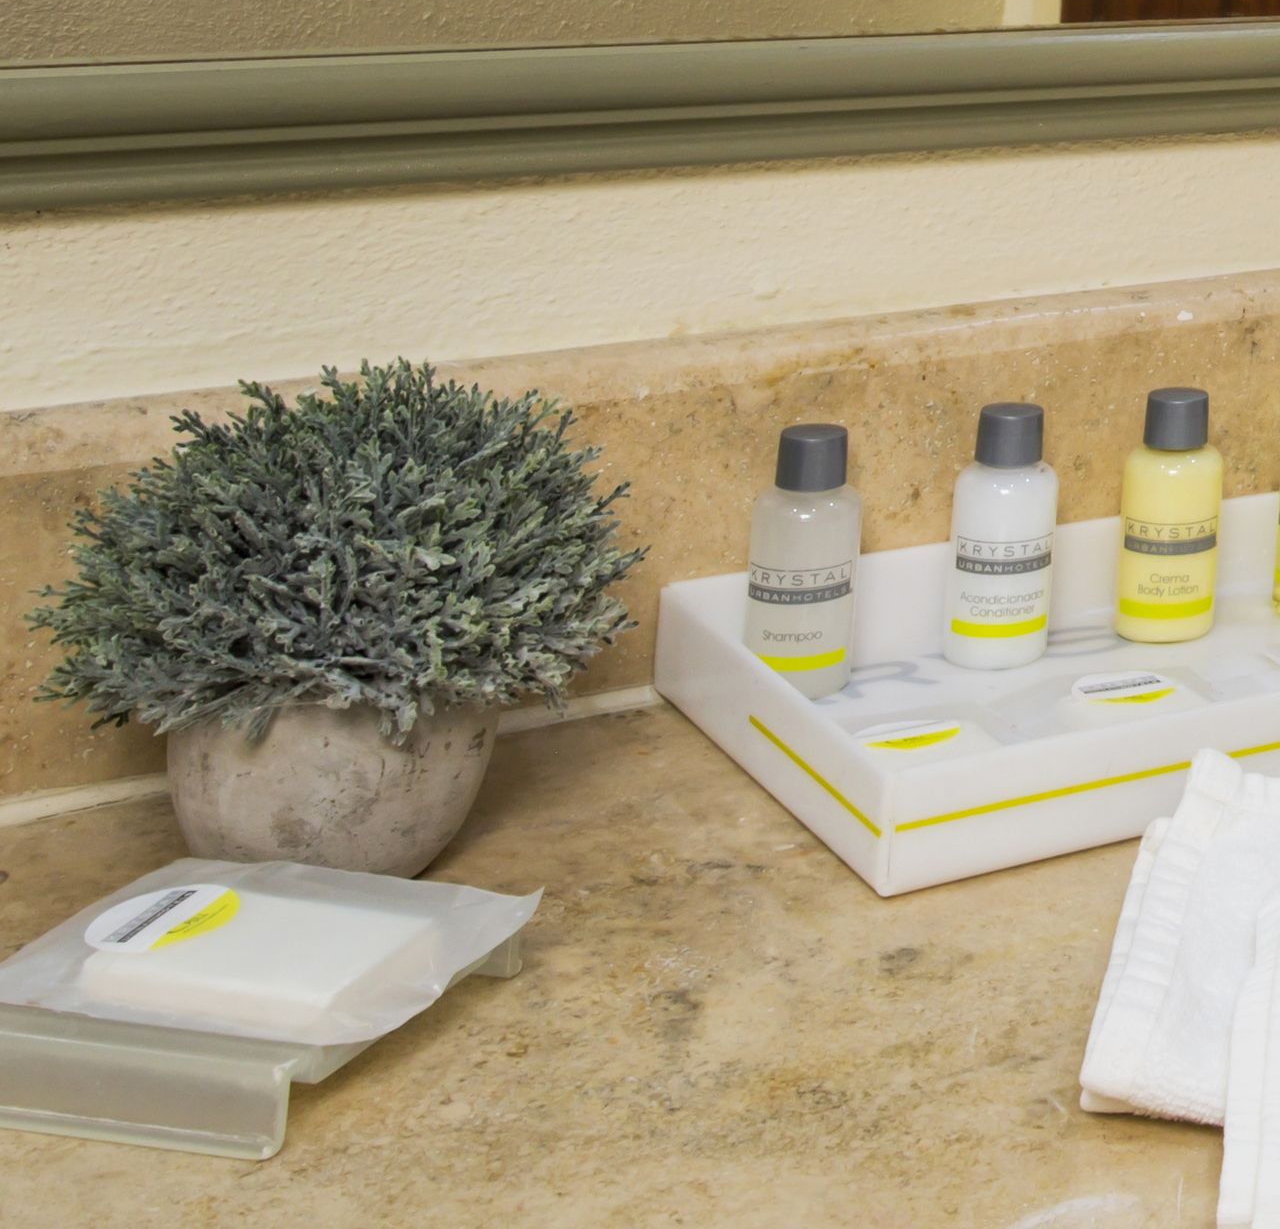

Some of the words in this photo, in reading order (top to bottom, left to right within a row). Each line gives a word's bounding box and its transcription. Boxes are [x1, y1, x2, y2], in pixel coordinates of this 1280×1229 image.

[1127, 522, 1216, 540] KRYSTAL
[959, 538, 1052, 558] KRYSTAL
[751, 567, 848, 587] KRYSTAL
[1150, 572, 1190, 585] Crema
[1137, 582, 1165, 598] Body
[1168, 584, 1199, 596] Lotion
[970, 603, 1036, 619] Conditioner
[762, 629, 823, 644] Shampoo
